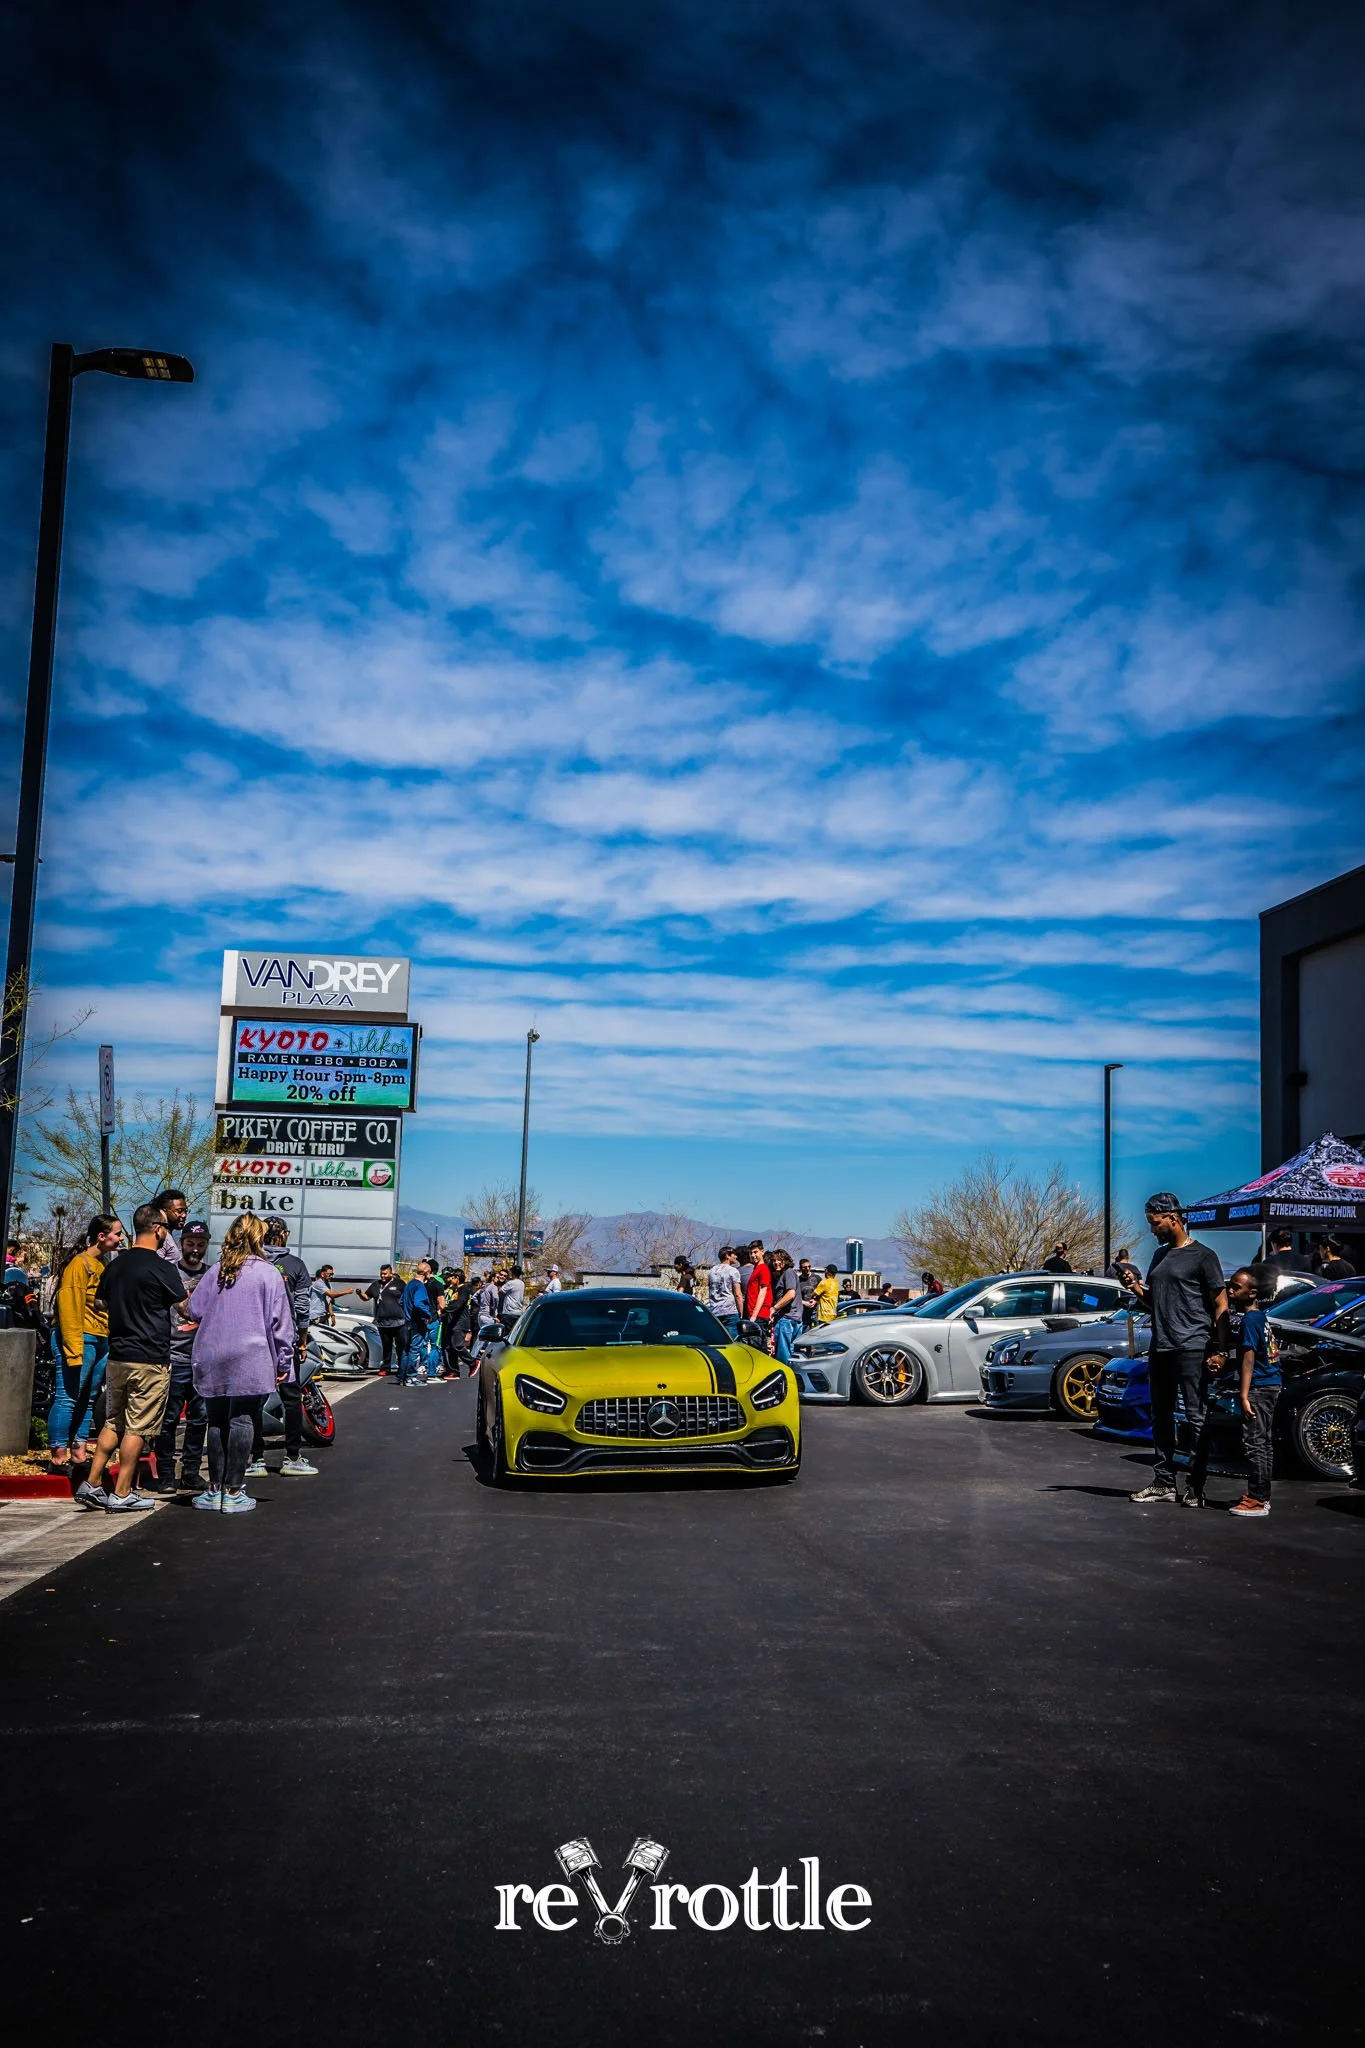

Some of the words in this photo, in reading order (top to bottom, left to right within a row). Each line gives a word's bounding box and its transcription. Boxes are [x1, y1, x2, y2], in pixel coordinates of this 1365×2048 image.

[241, 957, 400, 994] VANDREY
[282, 991, 355, 1007] PLAZA
[238, 1027, 329, 1051] KYOTO
[349, 1028, 408, 1055] Lilikoi
[247, 1054, 300, 1064] RAMEN
[314, 1056, 344, 1066] BBQ
[358, 1059, 398, 1068] BOBA
[237, 1067, 289, 1082] Happy
[292, 1069, 331, 1082] Hour
[334, 1070, 406, 1086] 5pm-8pm
[286, 1084, 323, 1100] 20%
[328, 1086, 357, 1101] off
[222, 1117, 283, 1140] PIKEY
[286, 1118, 357, 1143] COFFEE
[365, 1121, 392, 1145] CO.
[266, 1141, 306, 1155] DRIVE
[309, 1143, 346, 1156] THRU
[220, 1159, 292, 1176] KYOTO
[310, 1160, 359, 1179] Lilikoi
[220, 1176, 265, 1185] RAMEN
[275, 1177, 301, 1185] BBQ
[314, 1179, 348, 1187] BOBA
[219, 1189, 294, 1211] bake
